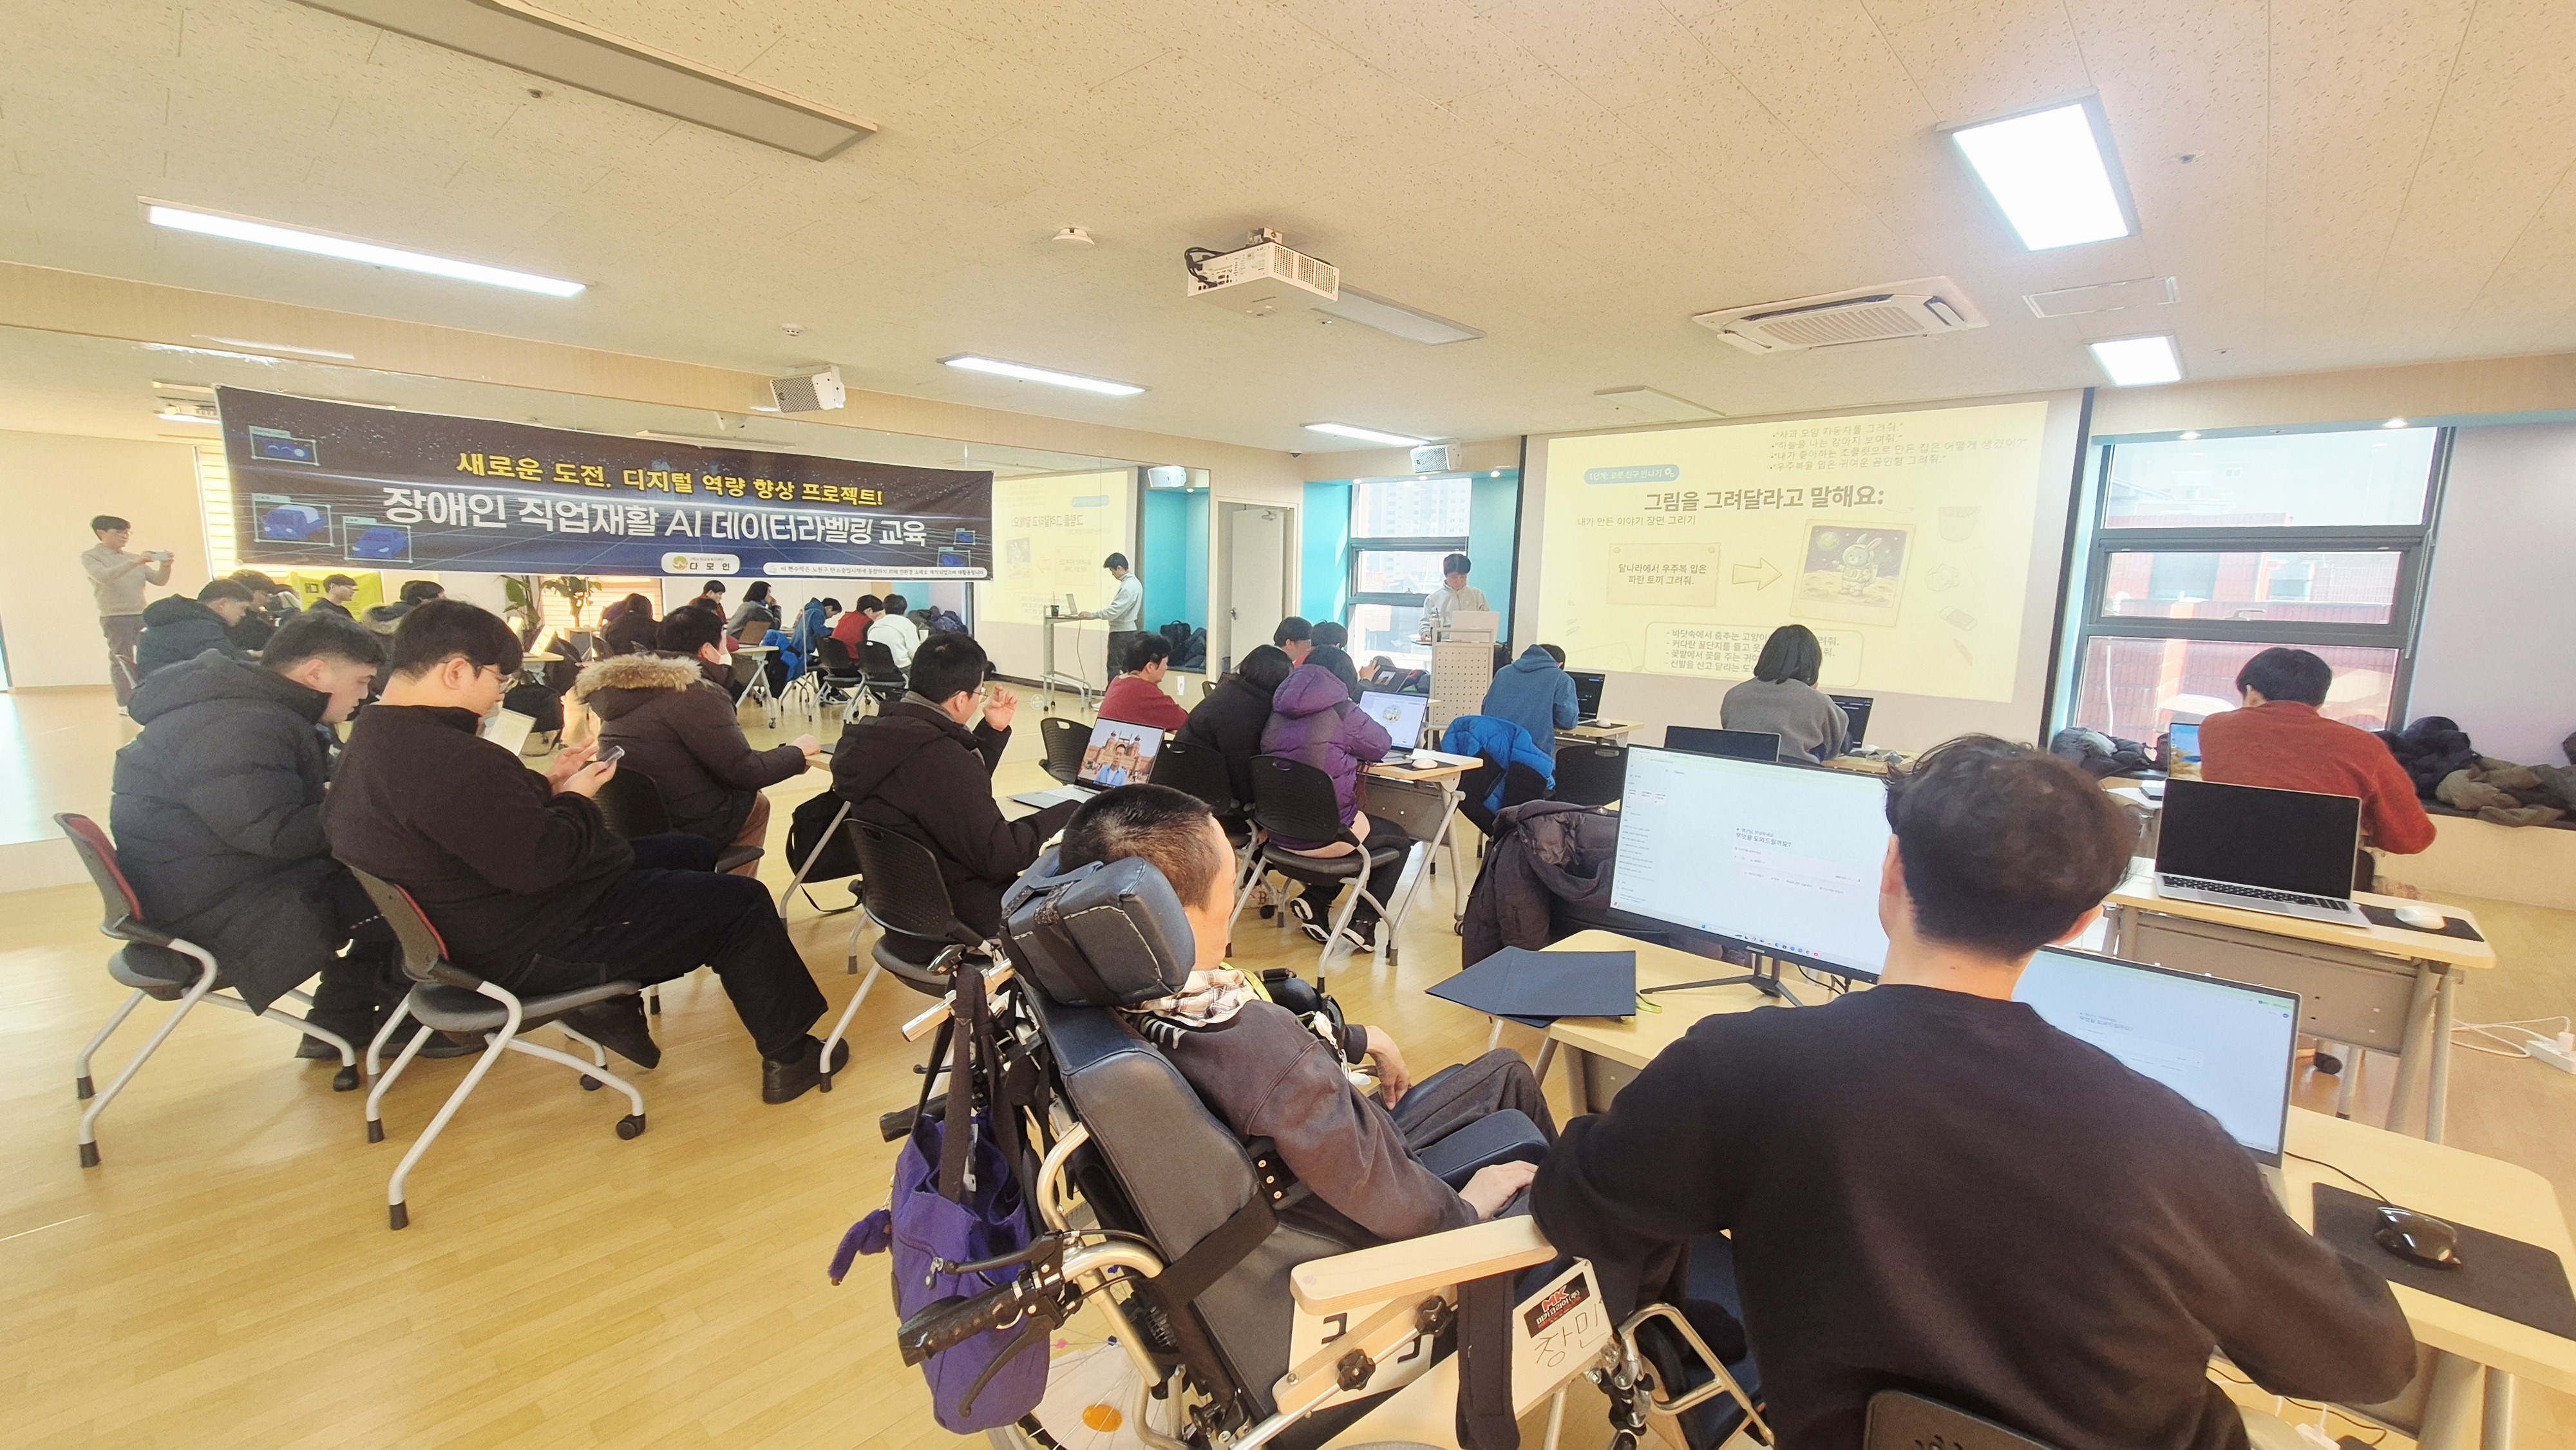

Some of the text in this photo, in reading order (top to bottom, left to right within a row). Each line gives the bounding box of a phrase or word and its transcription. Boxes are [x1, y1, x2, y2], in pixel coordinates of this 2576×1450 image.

[1801, 428, 1820, 437] 모양
[1823, 424, 1862, 436] 자동차를
[1810, 439, 1828, 447] 나는
[1832, 436, 1861, 447] 강아지
[456, 453, 544, 482] 새로운
[623, 468, 693, 494] 디지털
[702, 475, 746, 498] 역량
[753, 478, 795, 501] 향상
[801, 482, 884, 506] 프로젝트!
[1644, 484, 1885, 512] 그림을 그려달라고 말해요:
[383, 487, 927, 547] 장애인 직업재활 AI 데이터라벨링 교육
[1578, 514, 1696, 527] 내가 만든 이야기 장면 그리기
[1618, 563, 1707, 574] 달나라에서 우주복 입은
[1629, 575, 1694, 585] 파란 토끼 그려줘.
[1672, 629, 1712, 639] 바닷속에서
[1715, 631, 1739, 641] 춤추는
[1742, 633, 1772, 642] 고양이
[1672, 639, 1696, 648] 커다란
[1724, 652, 1741, 662] 주는
[1671, 660, 1694, 669] 신발을
[1696, 661, 1712, 670] 신고
[1715, 663, 1740, 672] 달리는
[1542, 1285, 1570, 1313] MK
